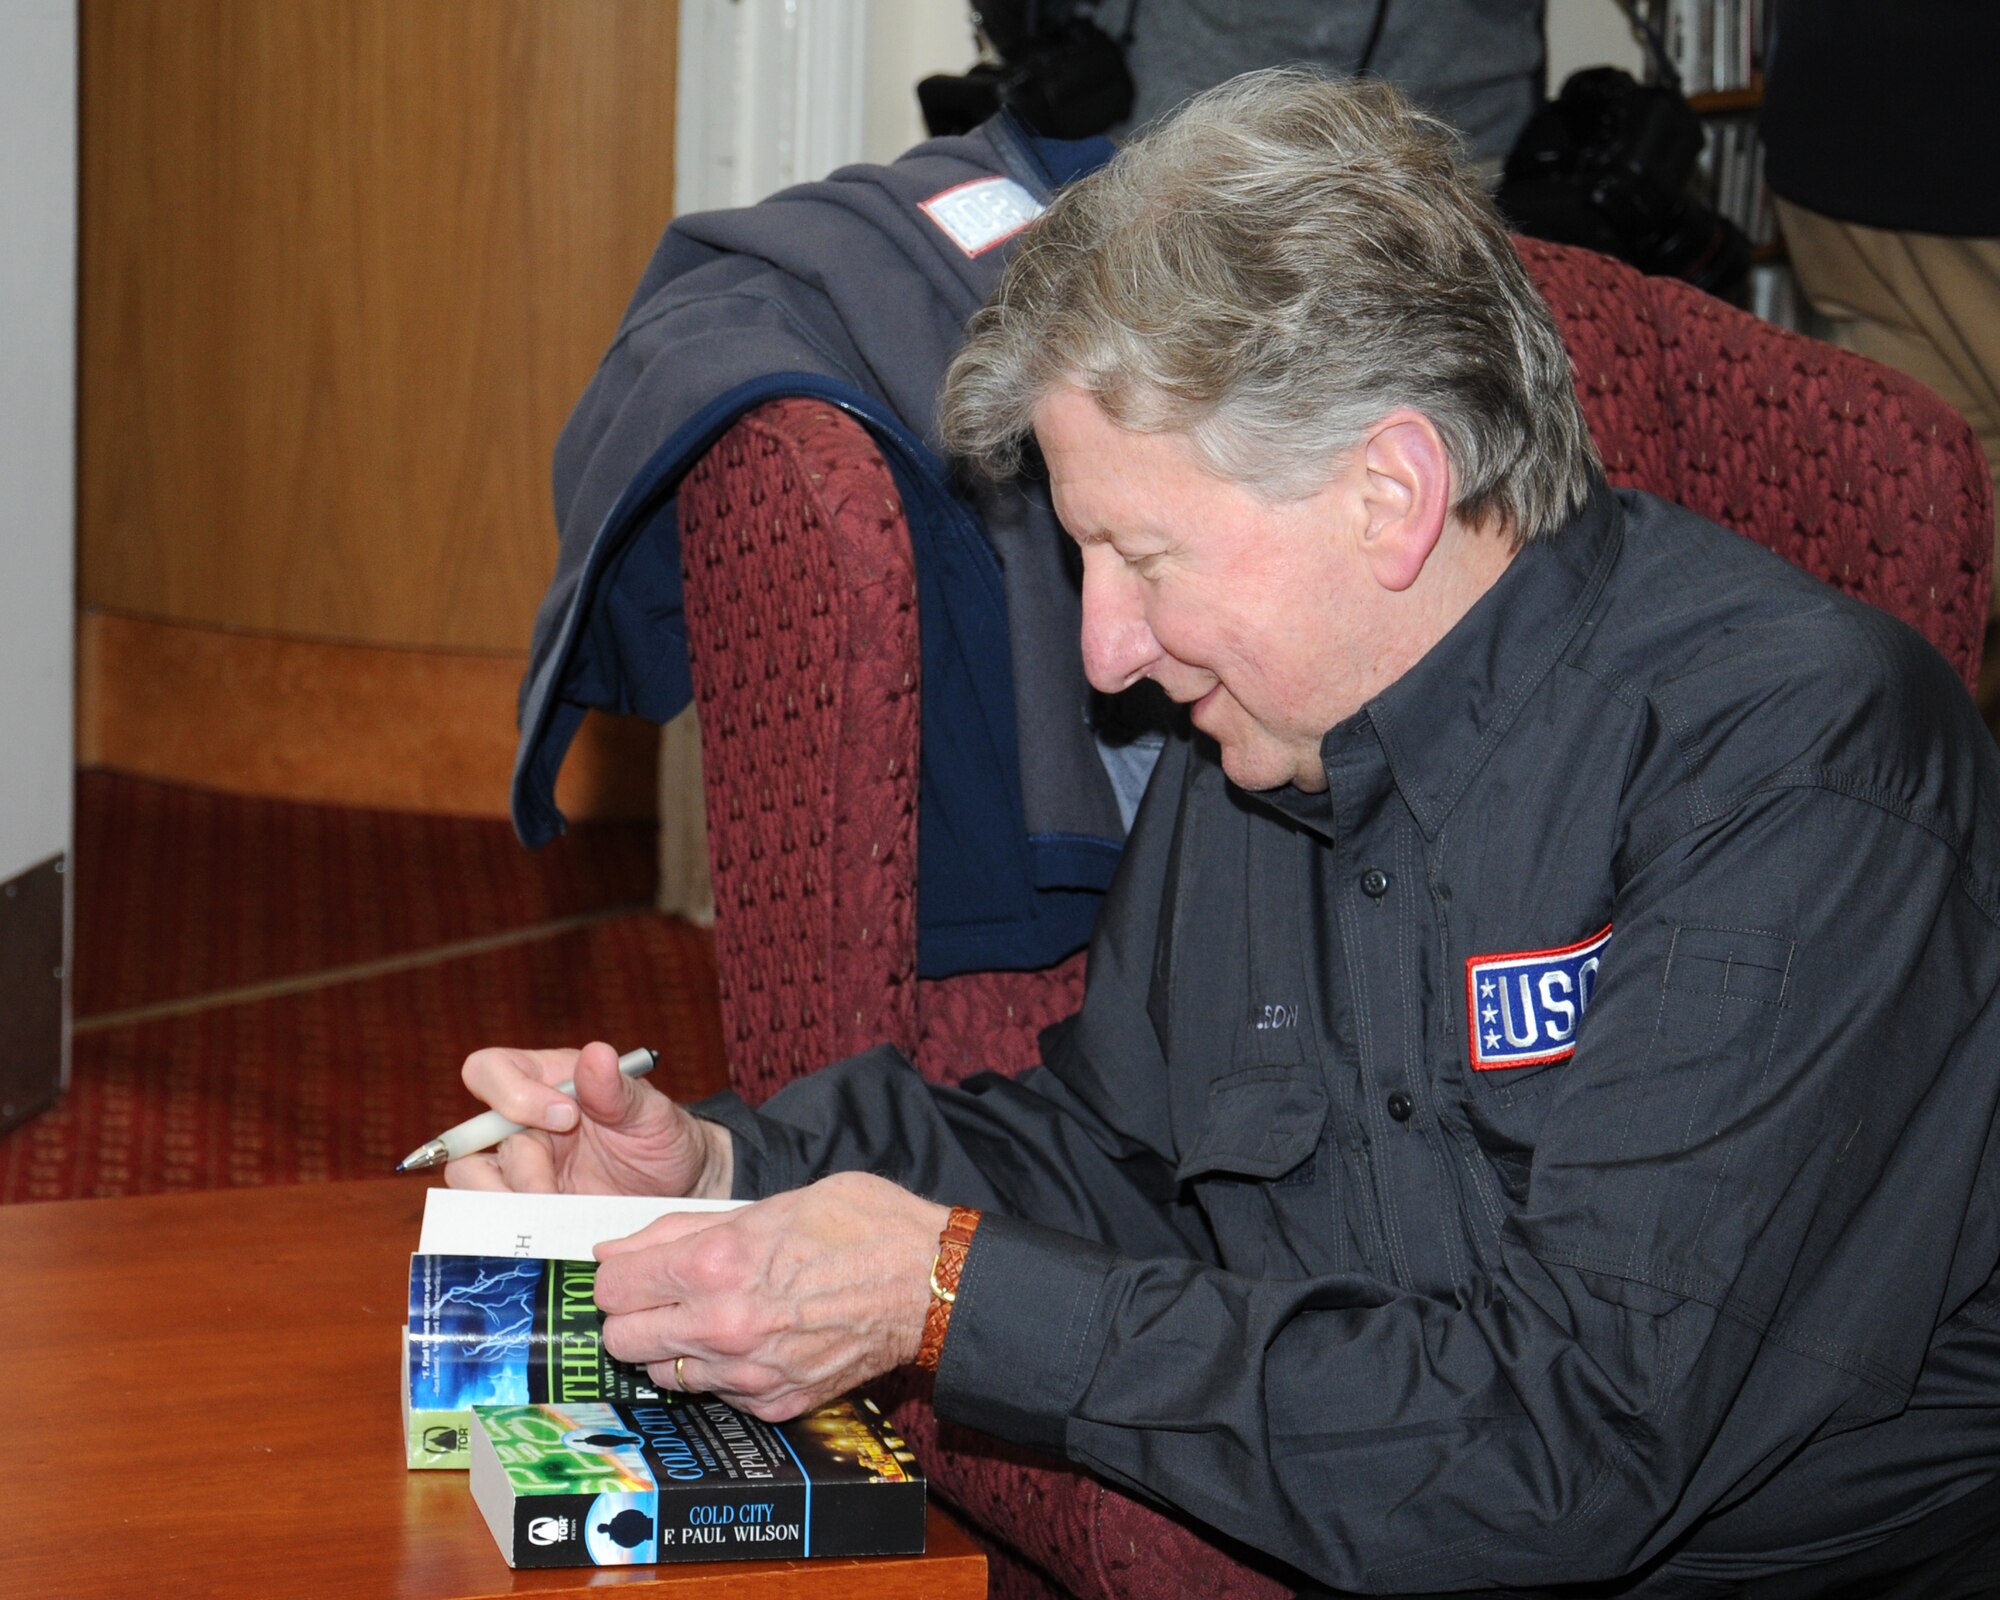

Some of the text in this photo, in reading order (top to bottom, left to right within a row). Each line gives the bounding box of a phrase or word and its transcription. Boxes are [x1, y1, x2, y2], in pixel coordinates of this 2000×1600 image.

[562, 1332, 599, 1402] THE
[701, 1403, 748, 1439] WILSON
[457, 1427, 469, 1452] TOR
[629, 1406, 704, 1480] COLD CITY
[728, 1440, 768, 1468] PAUL
[744, 1469, 774, 1479] F.
[689, 1503, 774, 1525] COLD CITY
[558, 1517, 568, 1542] TOR
[664, 1524, 800, 1545] F. PAUL WILSON
